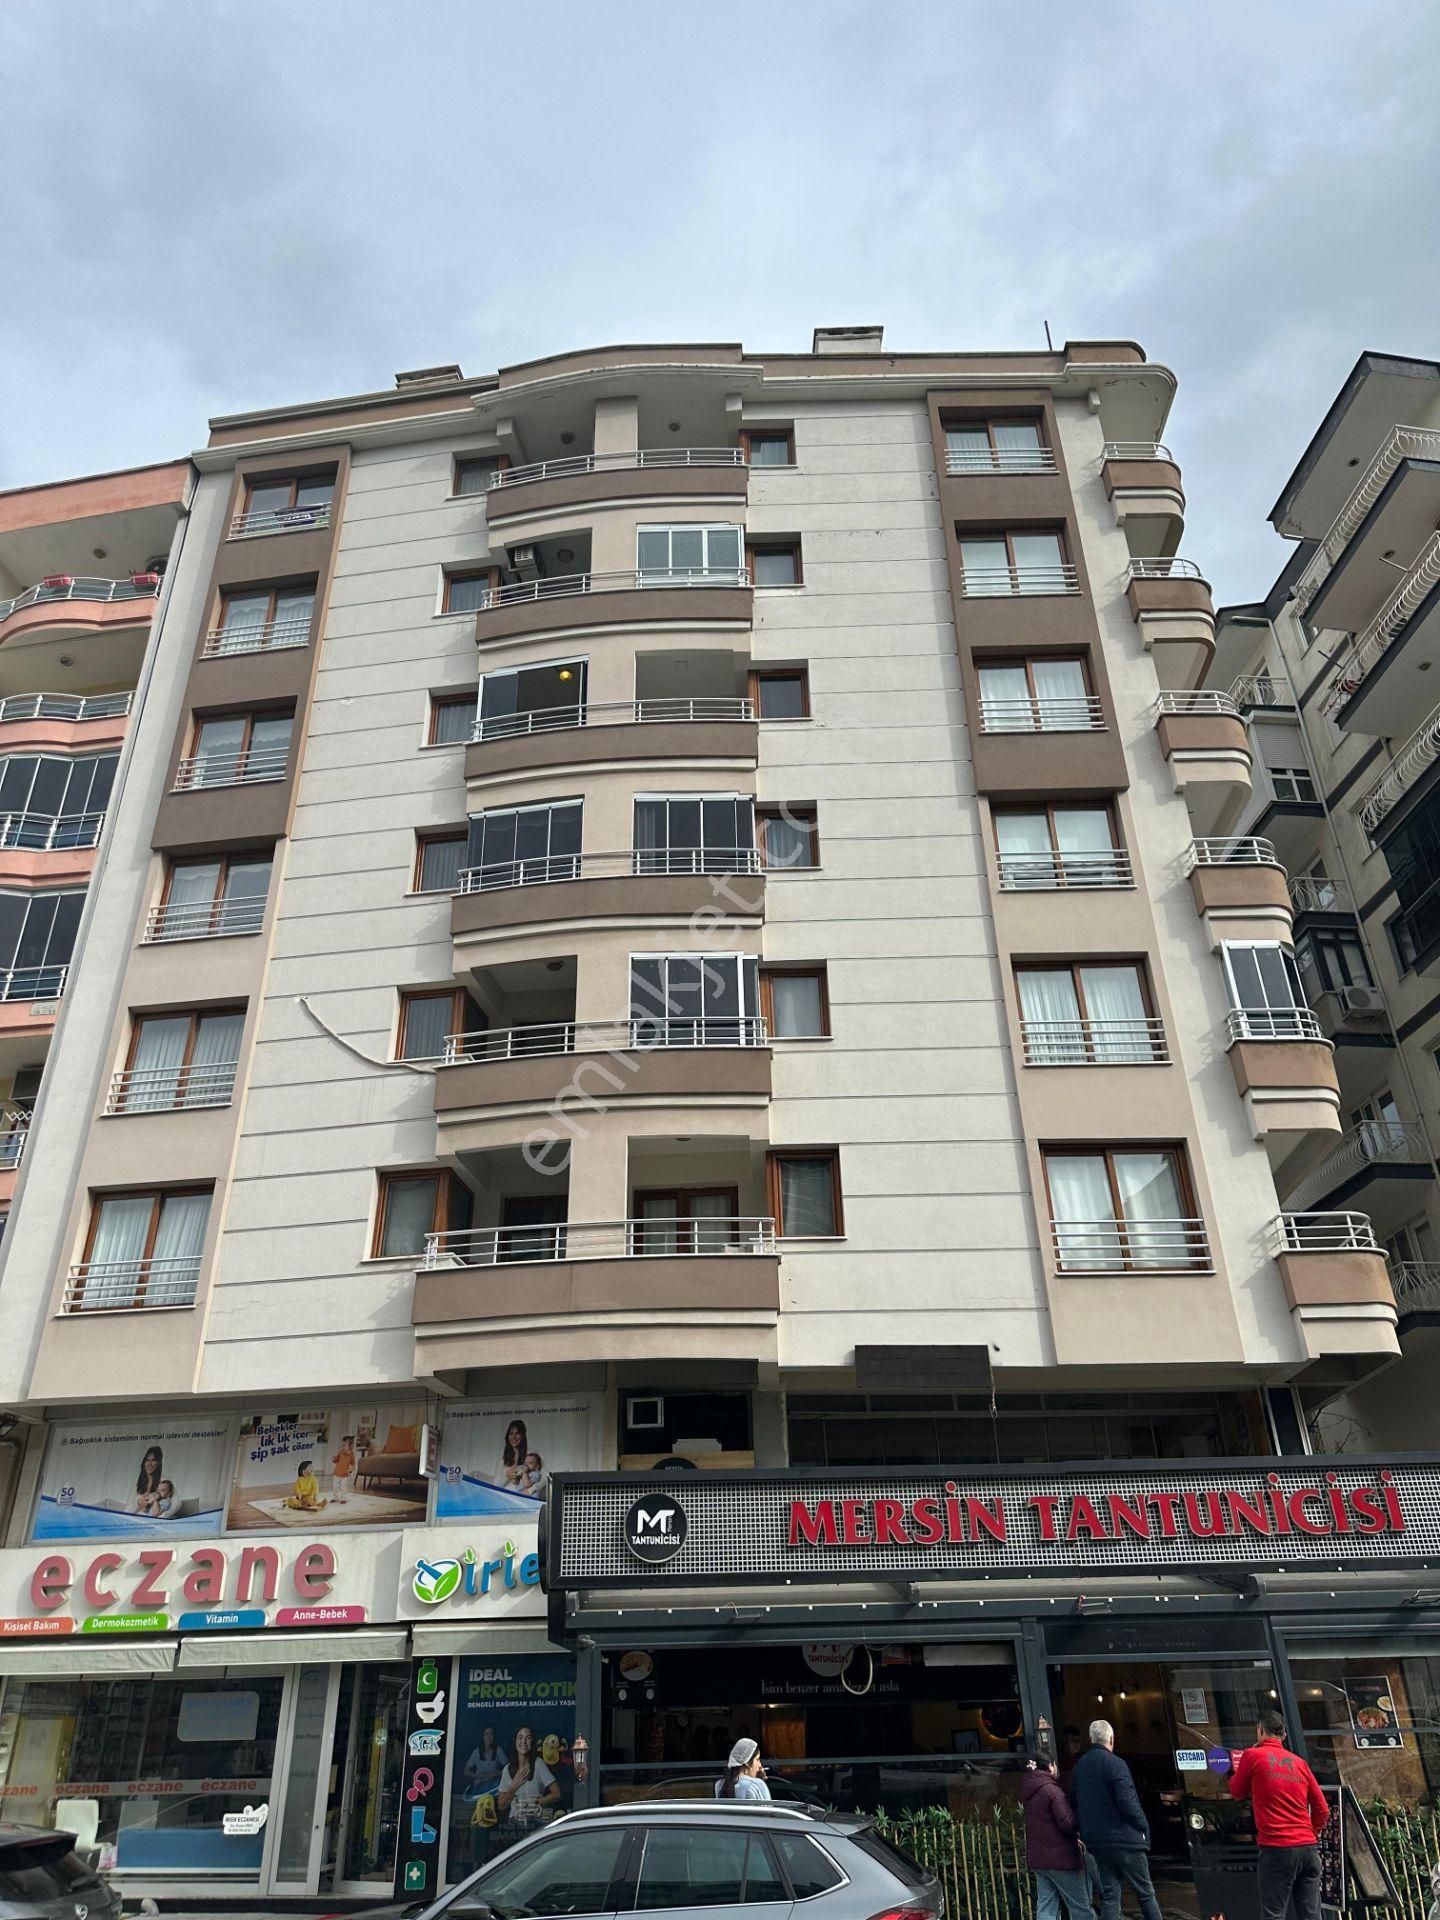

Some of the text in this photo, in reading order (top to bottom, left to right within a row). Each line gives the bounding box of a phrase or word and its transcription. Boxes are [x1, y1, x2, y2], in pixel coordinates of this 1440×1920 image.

[257, 1423, 298, 1435] Bebekler
[292, 1430, 310, 1440] içer
[140, 1432, 165, 1441] normal
[250, 1441, 315, 1462] şip şak çözer
[449, 1466, 461, 1475] 50
[60, 1487, 75, 1497] 50
[788, 1470, 1407, 1546] MERSİN TANTUNİCİSİ
[631, 1532, 681, 1545] TANTUNİCİSİ
[30, 1543, 338, 1609] eczane
[206, 1614, 239, 1624] Vitamin
[293, 1608, 348, 1620] Anne-Bebek
[4, 1619, 60, 1632] Kişisel Bakım
[92, 1616, 159, 1629] Dermokozmetik
[468, 1668, 513, 1682] İDEAL
[468, 1681, 576, 1699] PROBİYOTİK
[786, 1681, 821, 1694] benzer
[467, 1700, 495, 1708] DENGELİ
[529, 1699, 558, 1707] SAĞLIKLI
[1177, 1751, 1205, 1762] SETCARD
[55, 1782, 110, 1795] eczane
[127, 1780, 183, 1793] eczane
[201, 1778, 257, 1791] eczane
